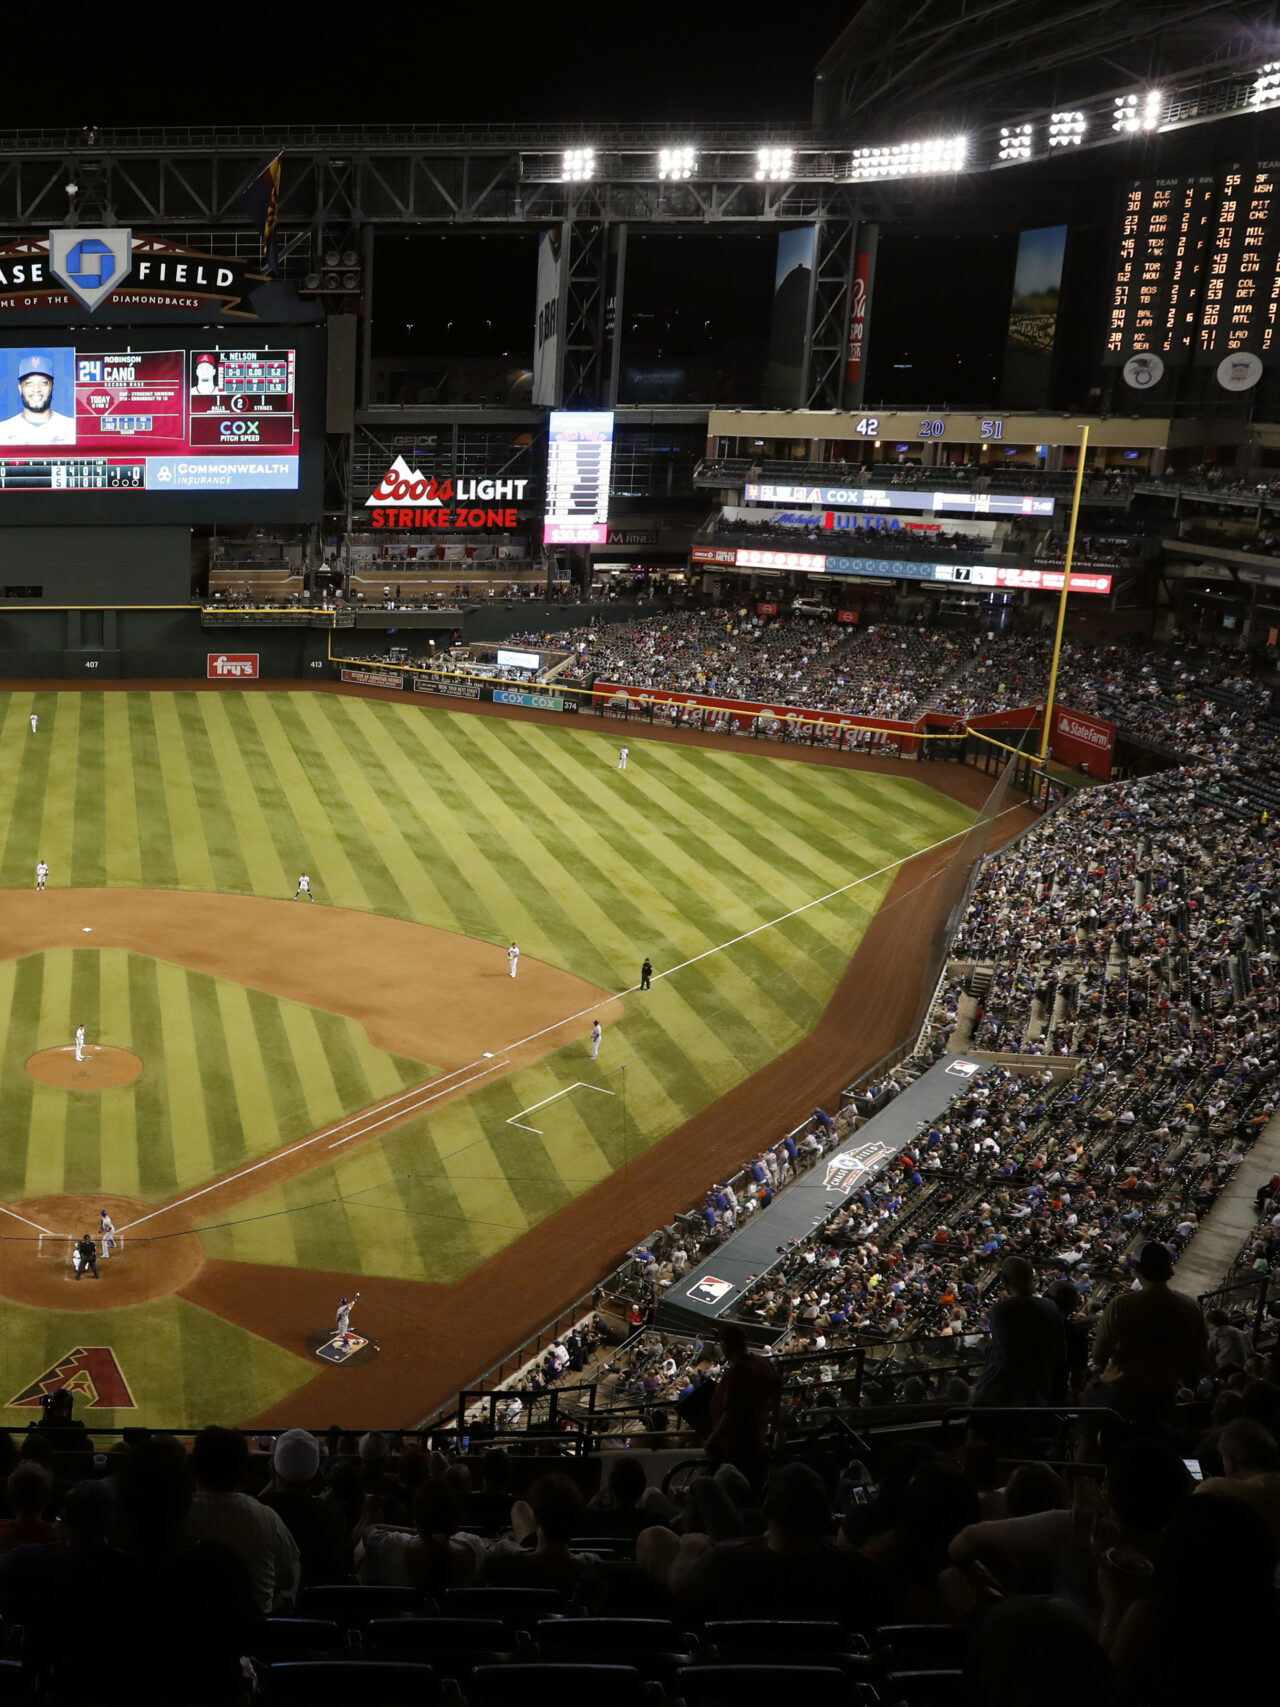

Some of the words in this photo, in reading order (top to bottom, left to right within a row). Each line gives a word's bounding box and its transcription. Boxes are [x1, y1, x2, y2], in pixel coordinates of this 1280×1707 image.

[139, 262, 234, 286] FIELD
[24, 297, 38, 305] OF
[48, 296, 68, 304] THE
[113, 296, 198, 307] DIAMONDBACKS
[79, 361, 101, 381] 24
[220, 421, 259, 434] COX
[856, 419, 879, 435] 42
[919, 420, 945, 437] 20
[980, 420, 1002, 439] 51
[178, 463, 289, 474] COMMONWEALTH
[178, 476, 232, 485] INSURANCE
[373, 469, 455, 501] Coors
[457, 479, 528, 500] LIGHT
[827, 491, 858, 503] COX
[372, 509, 450, 527] STRIKE
[455, 509, 518, 527] ZONE
[502, 693, 524, 704] COX
[532, 697, 554, 708] COX
[564, 702, 576, 710] 374
[831, 1169, 848, 1185] CHASE
